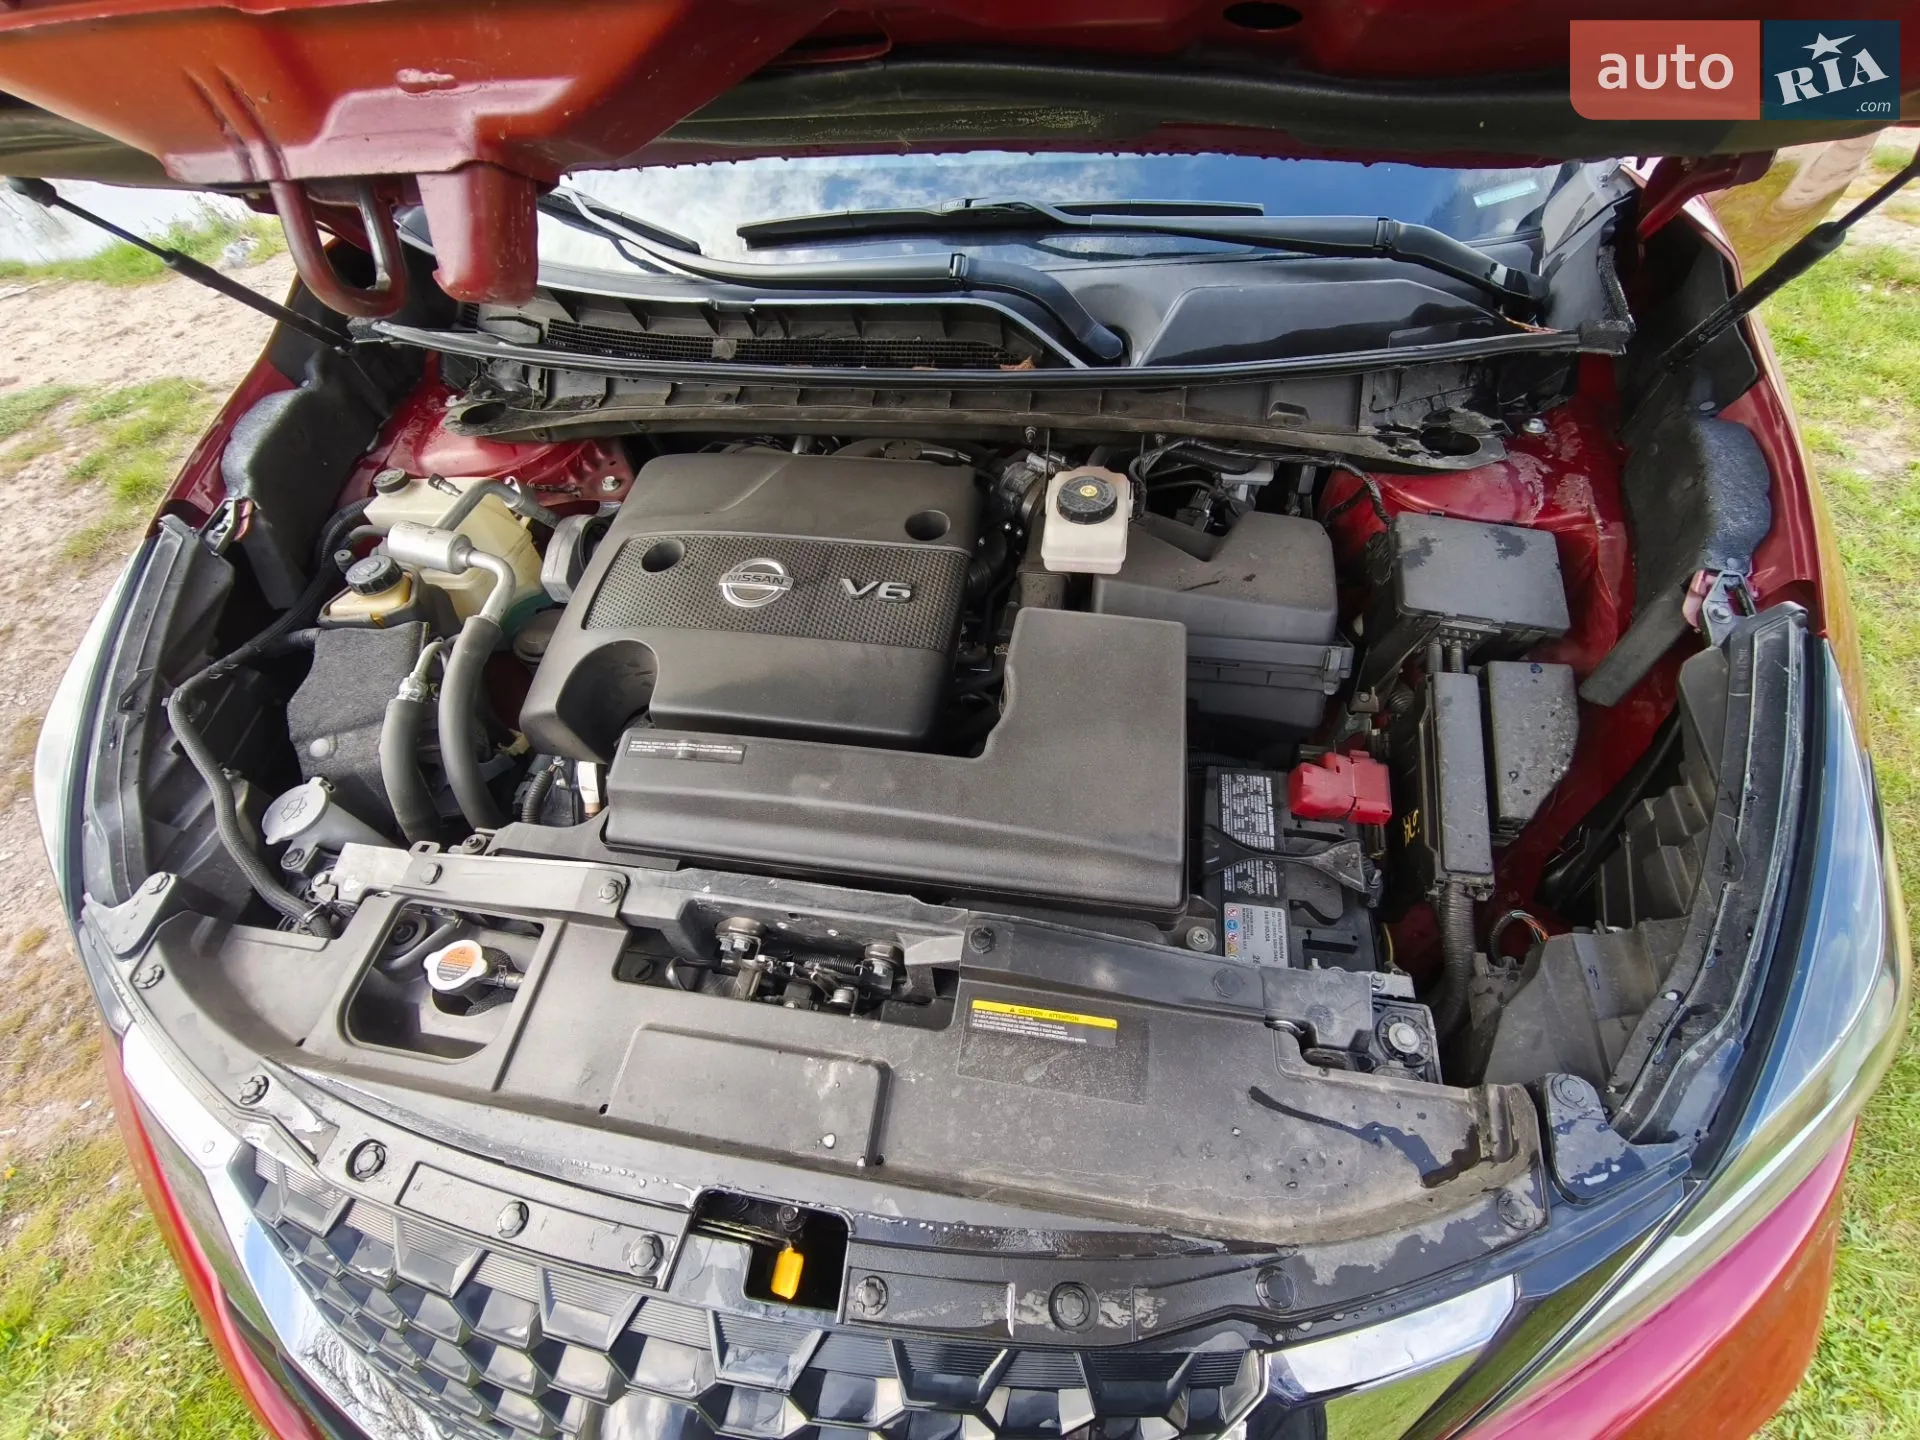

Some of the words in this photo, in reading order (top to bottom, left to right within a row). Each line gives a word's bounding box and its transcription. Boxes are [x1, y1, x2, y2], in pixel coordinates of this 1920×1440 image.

[727, 574, 785, 585] NISSAN
[840, 578, 912, 604] V6
[1018, 1008, 1043, 1017] CAUTION
